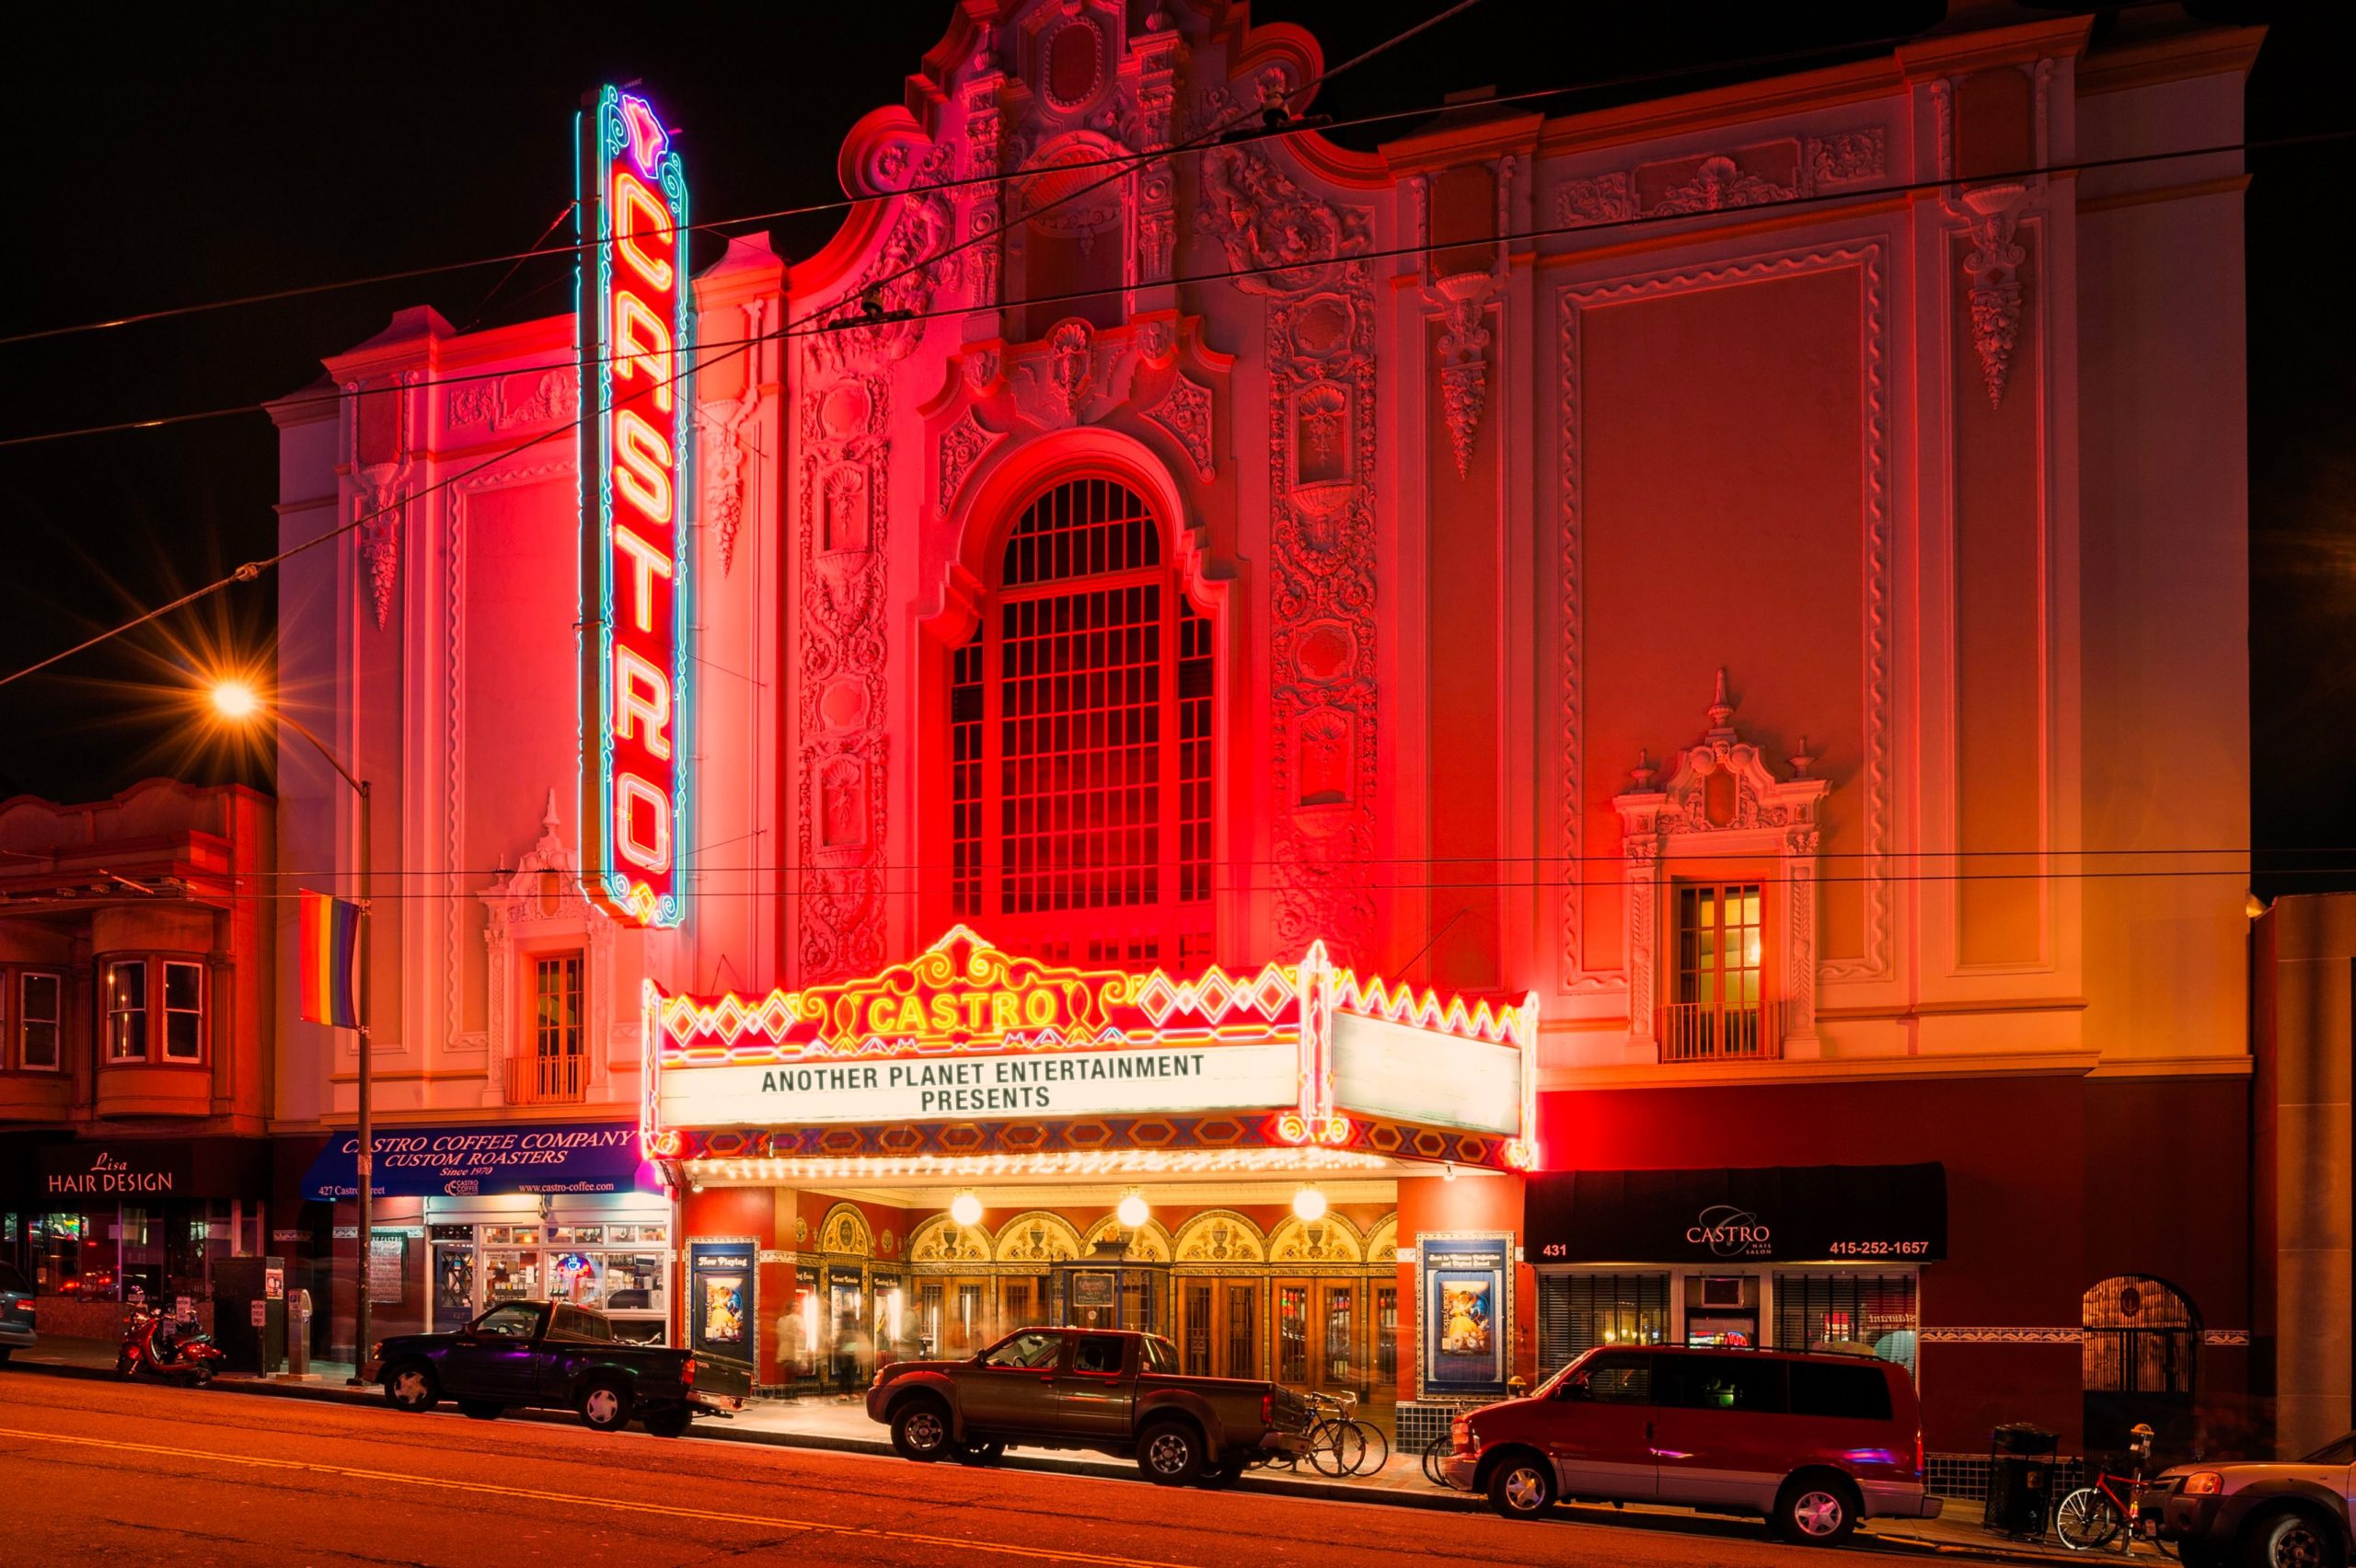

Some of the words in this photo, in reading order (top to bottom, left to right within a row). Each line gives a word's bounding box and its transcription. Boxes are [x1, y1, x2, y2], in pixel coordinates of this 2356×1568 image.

[615, 172, 673, 875] CASTRO
[868, 989, 1057, 1032] CASTRO
[761, 1067, 878, 1092] ANOTHER
[889, 1064, 985, 1088] PLANET
[995, 1055, 1205, 1083] ENTERTAINMENT
[921, 1087, 1050, 1112] PRESENTS
[342, 1136, 428, 1153] CSTRO
[433, 1134, 518, 1150] COFFEE
[520, 1130, 638, 1149] COMPANY
[90, 1152, 128, 1171] Lisa
[385, 1153, 464, 1167] CUSTOM
[467, 1150, 569, 1165] ROASTERS
[440, 1167, 468, 1176] Since
[470, 1166, 493, 1175] 1970
[48, 1175, 97, 1193] HAIR
[103, 1172, 172, 1192] DESIGN
[318, 1186, 333, 1195] 427
[370, 1186, 386, 1194] reet
[518, 1182, 615, 1193] www.castro-coffee.com
[1686, 1226, 1770, 1243] CASTRO
[1542, 1244, 1566, 1256] 431
[1830, 1241, 1929, 1254] 415-252-1657
[718, 1256, 747, 1267] Playing
